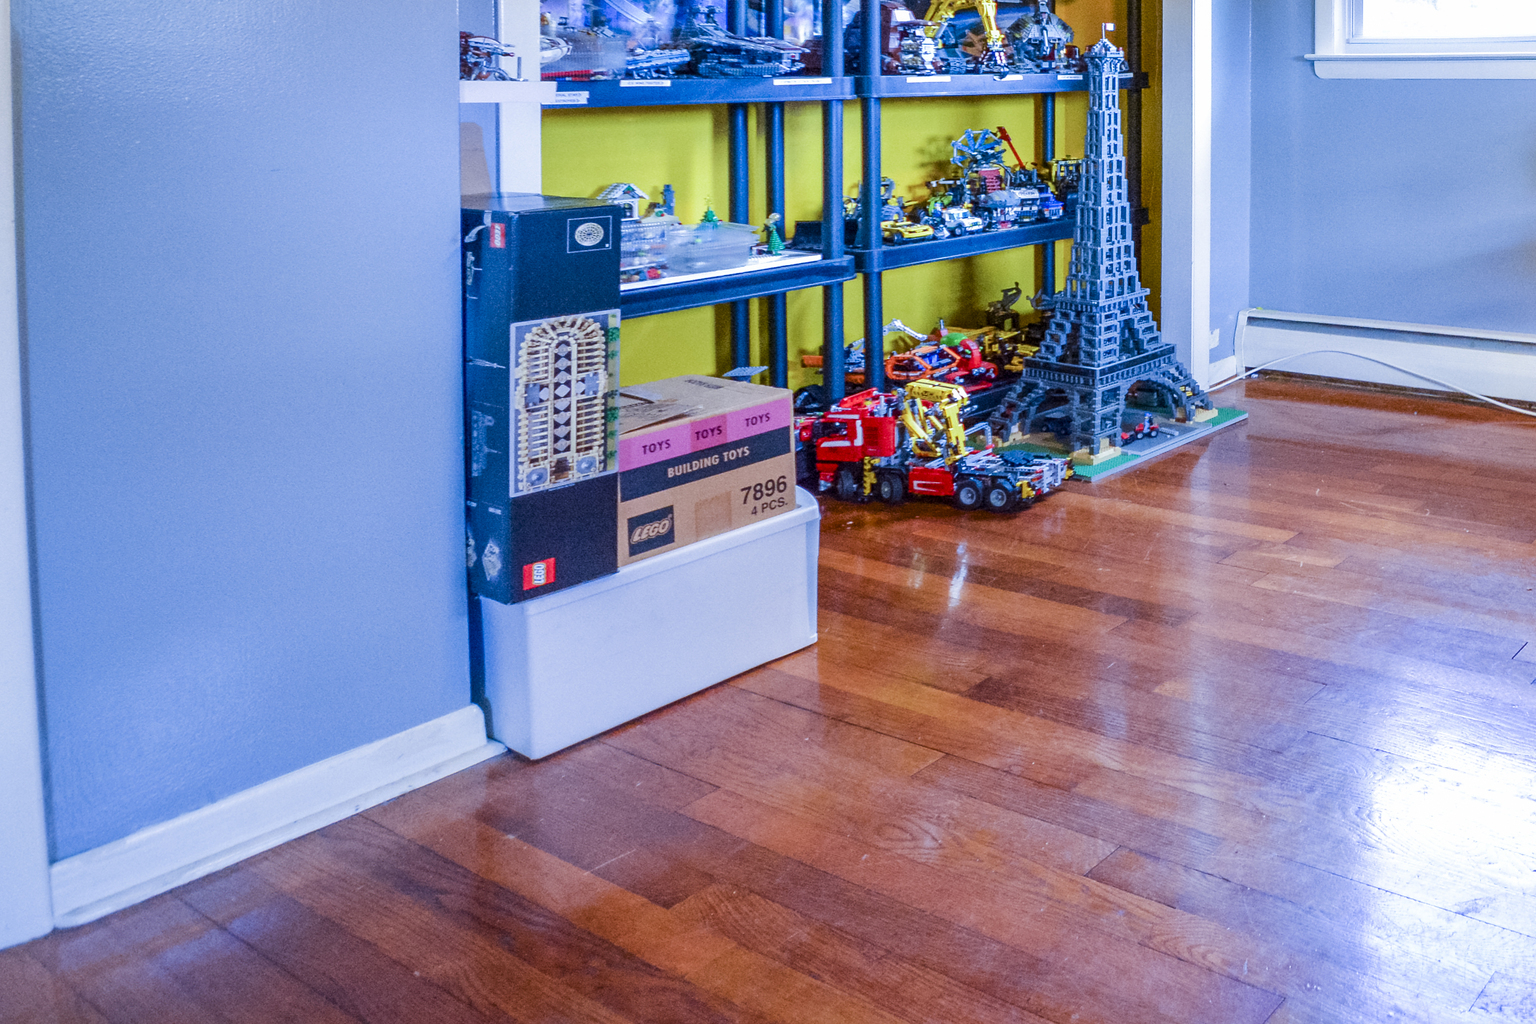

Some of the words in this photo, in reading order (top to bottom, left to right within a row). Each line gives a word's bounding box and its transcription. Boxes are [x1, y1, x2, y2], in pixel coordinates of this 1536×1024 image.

[642, 439, 671, 455] TOYS
[695, 426, 723, 441] TOYS
[745, 412, 771, 427] TOYS
[667, 454, 720, 478] BUILDING
[722, 446, 750, 462] TOYS
[740, 475, 787, 505] 7896
[751, 506, 758, 516] 4
[761, 497, 788, 514] PCS.
[631, 518, 672, 545] LEGO
[533, 562, 546, 585] LEGO
